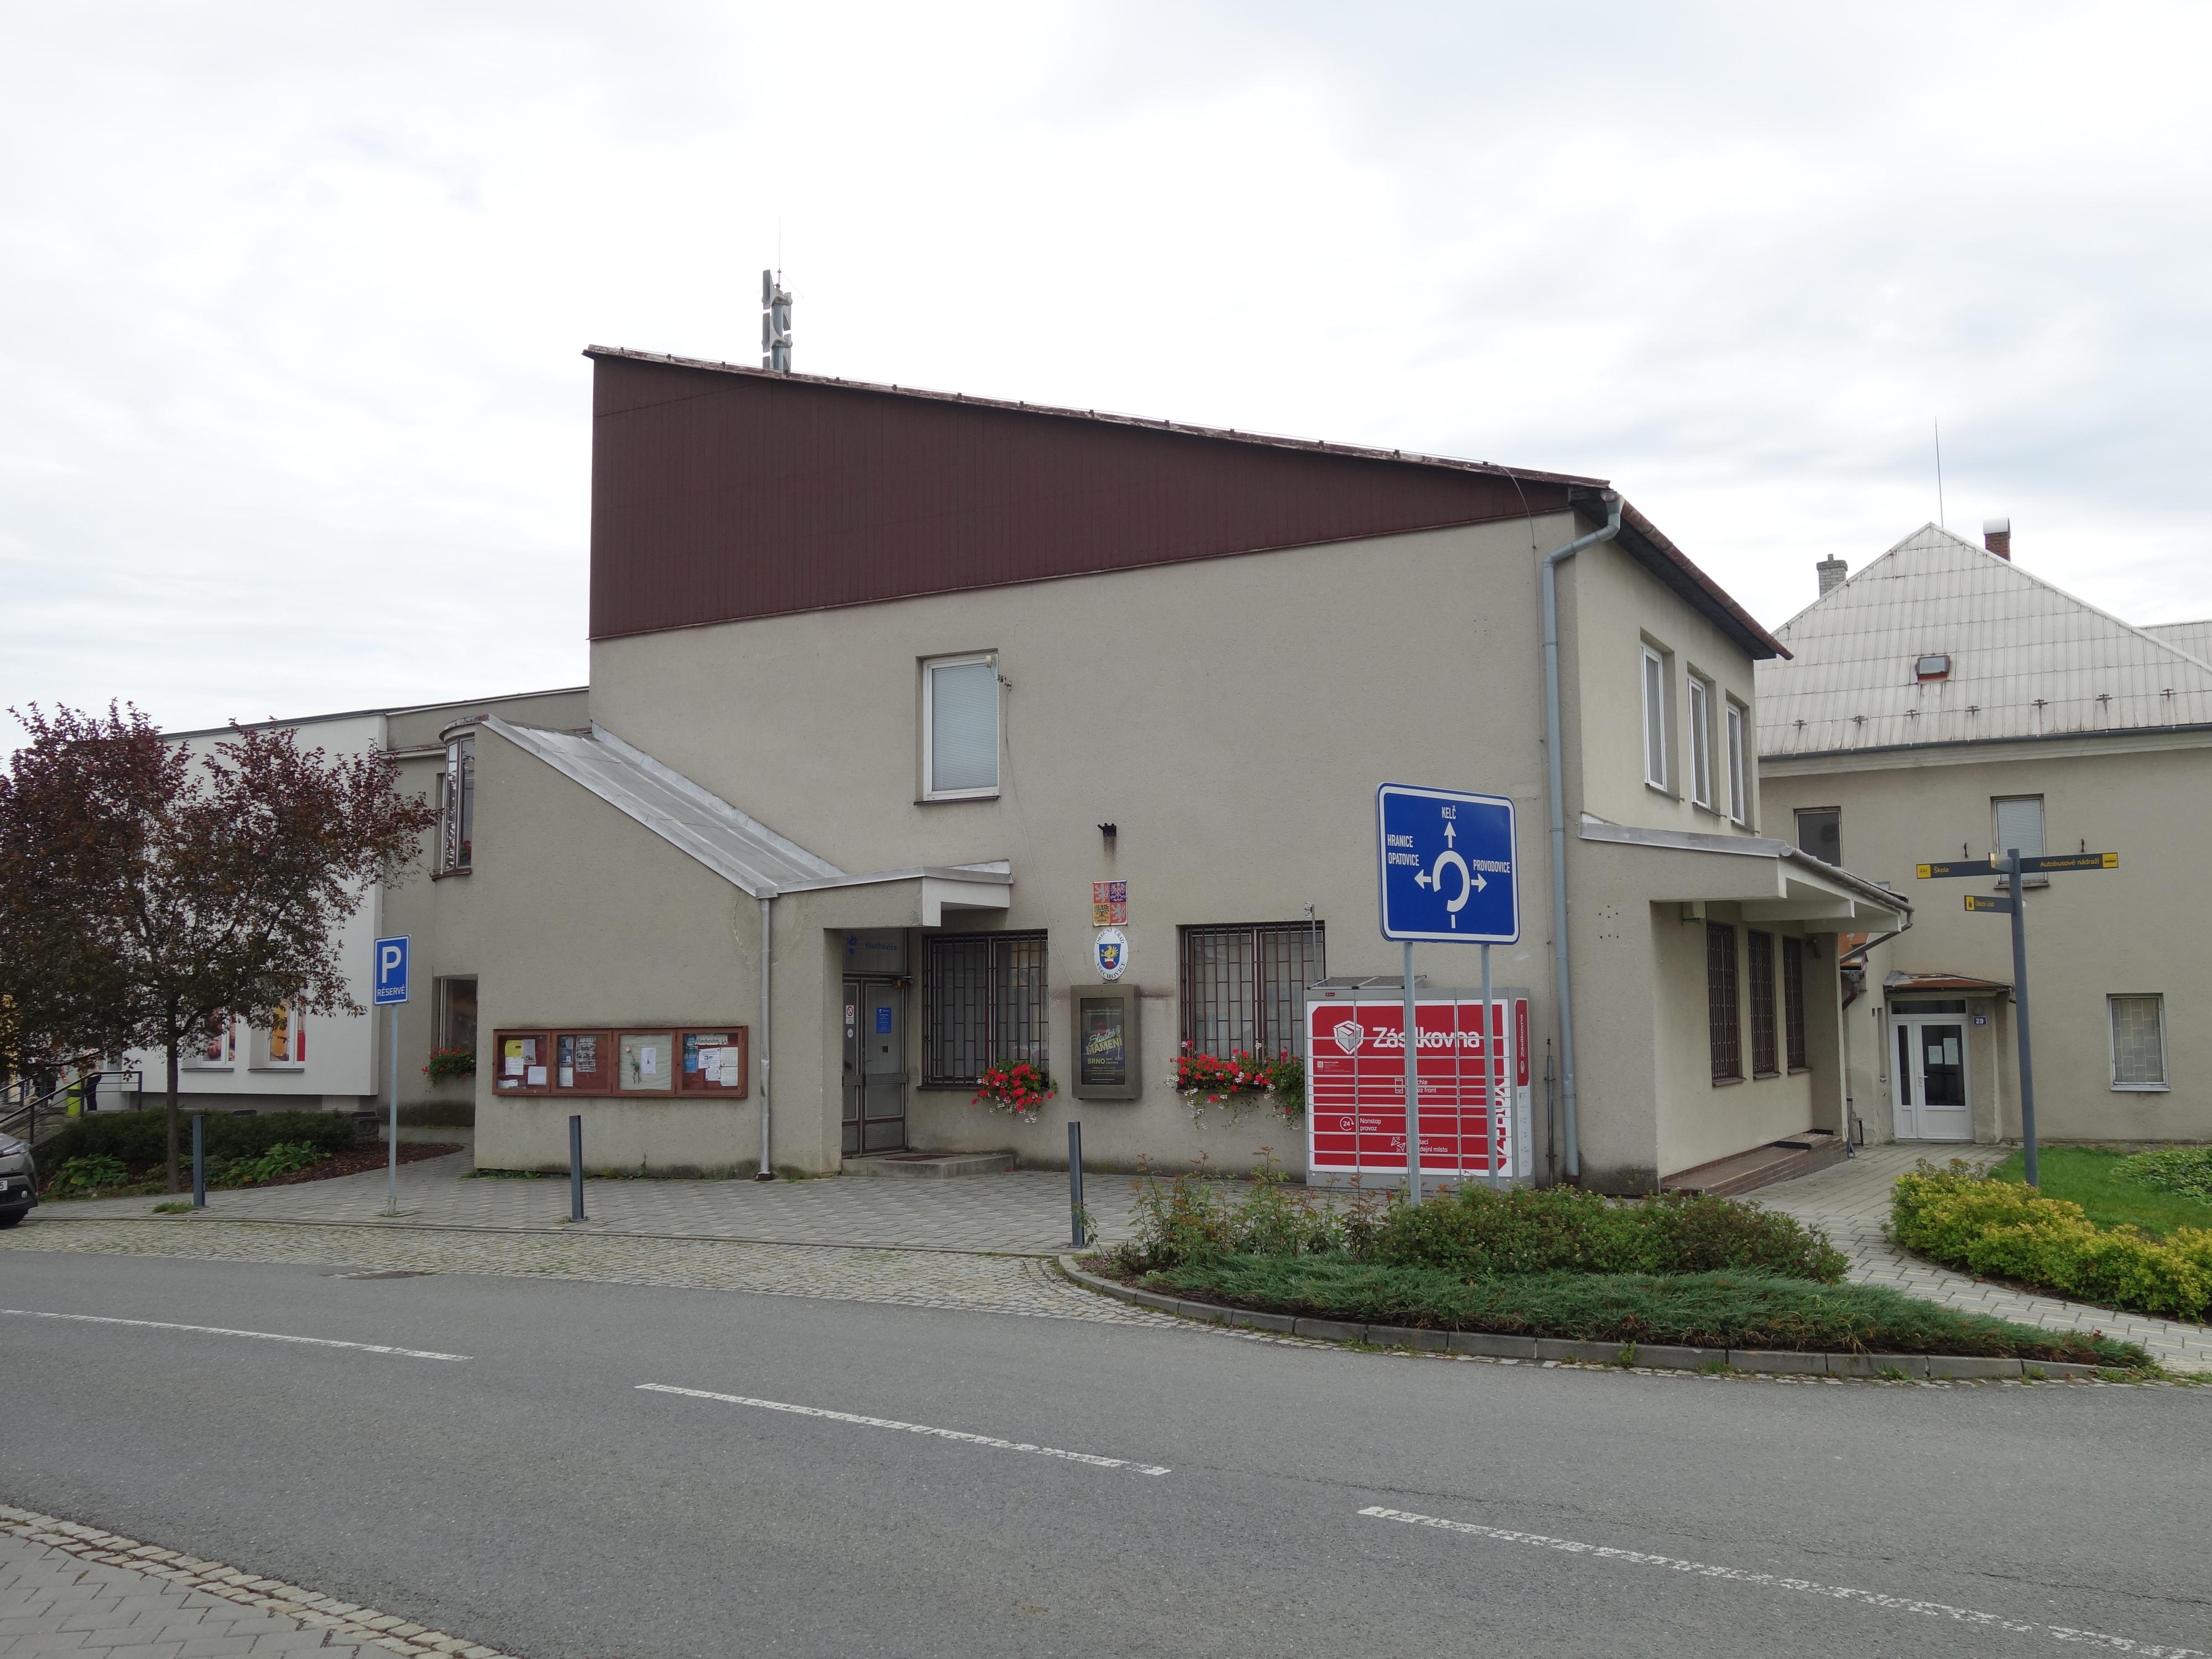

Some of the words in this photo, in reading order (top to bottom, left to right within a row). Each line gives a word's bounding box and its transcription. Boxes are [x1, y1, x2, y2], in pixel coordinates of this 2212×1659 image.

[1442, 805, 1456, 820] KELČ
[1387, 834, 1413, 848] HRANICE
[1388, 852, 1420, 867] OPATOVICE
[1473, 859, 1511, 873] PROVODOVICE
[2041, 859, 2075, 867] Autobusové
[382, 946, 401, 983] P
[377, 984, 405, 997] RÉSERVÉ
[1373, 1027, 1480, 1048] Záslkovna
